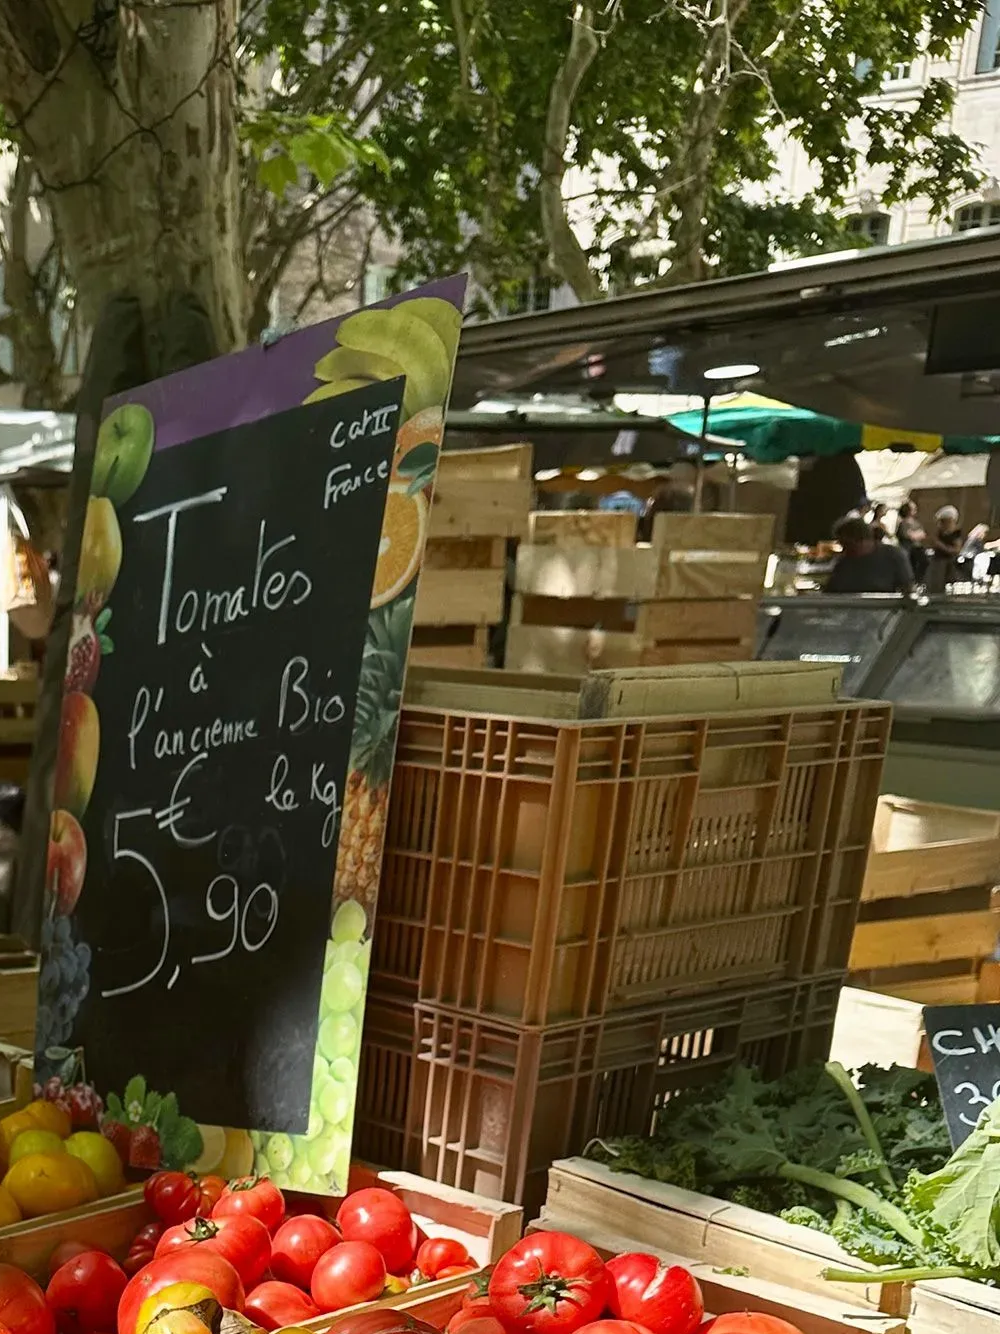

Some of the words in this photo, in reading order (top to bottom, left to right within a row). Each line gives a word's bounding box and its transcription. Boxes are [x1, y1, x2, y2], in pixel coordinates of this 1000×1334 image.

[323, 459, 389, 510] France
[132, 486, 313, 646] Tomates
[189, 642, 213, 694] à
[128, 685, 259, 771] l'ancienne
[278, 655, 346, 732] Bio
[264, 753, 300, 812] le
[932, 1023, 1000, 1055] CH
